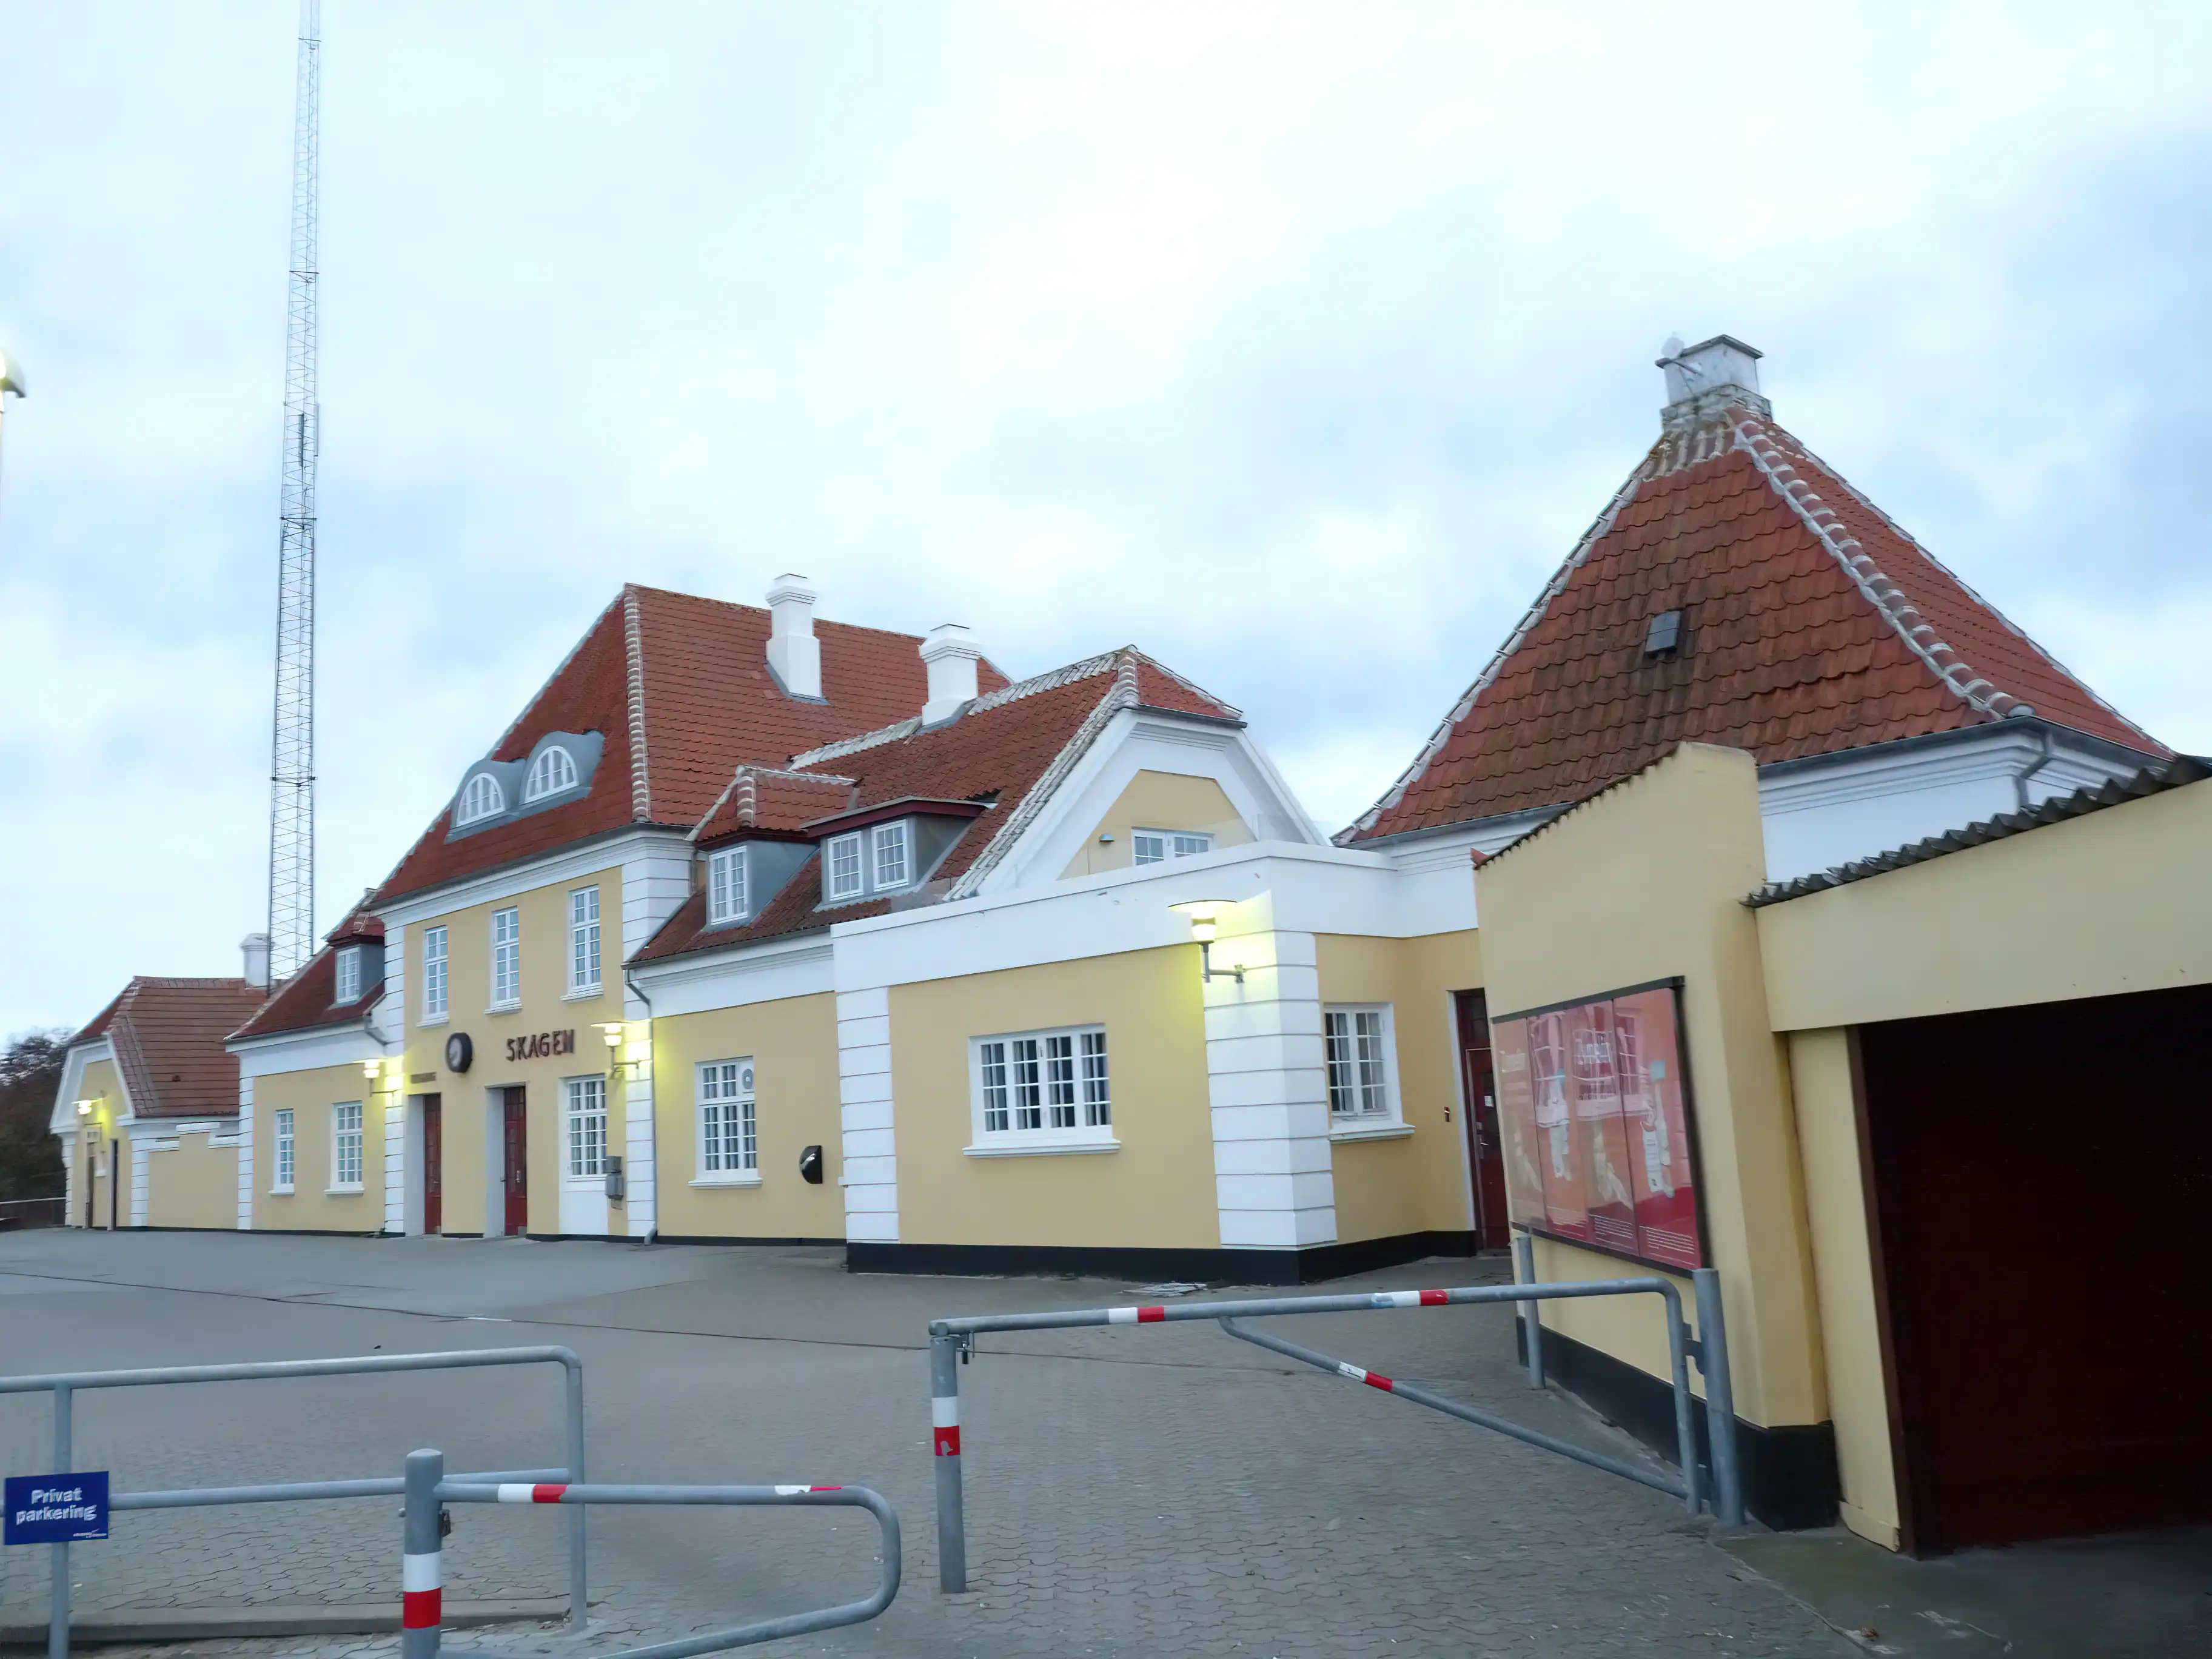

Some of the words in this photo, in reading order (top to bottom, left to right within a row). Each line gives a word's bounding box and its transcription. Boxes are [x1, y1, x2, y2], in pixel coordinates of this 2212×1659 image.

[506, 1029, 575, 1062] SKAGEN
[31, 1487, 83, 1504] Privat
[16, 1504, 98, 1526] parkering
